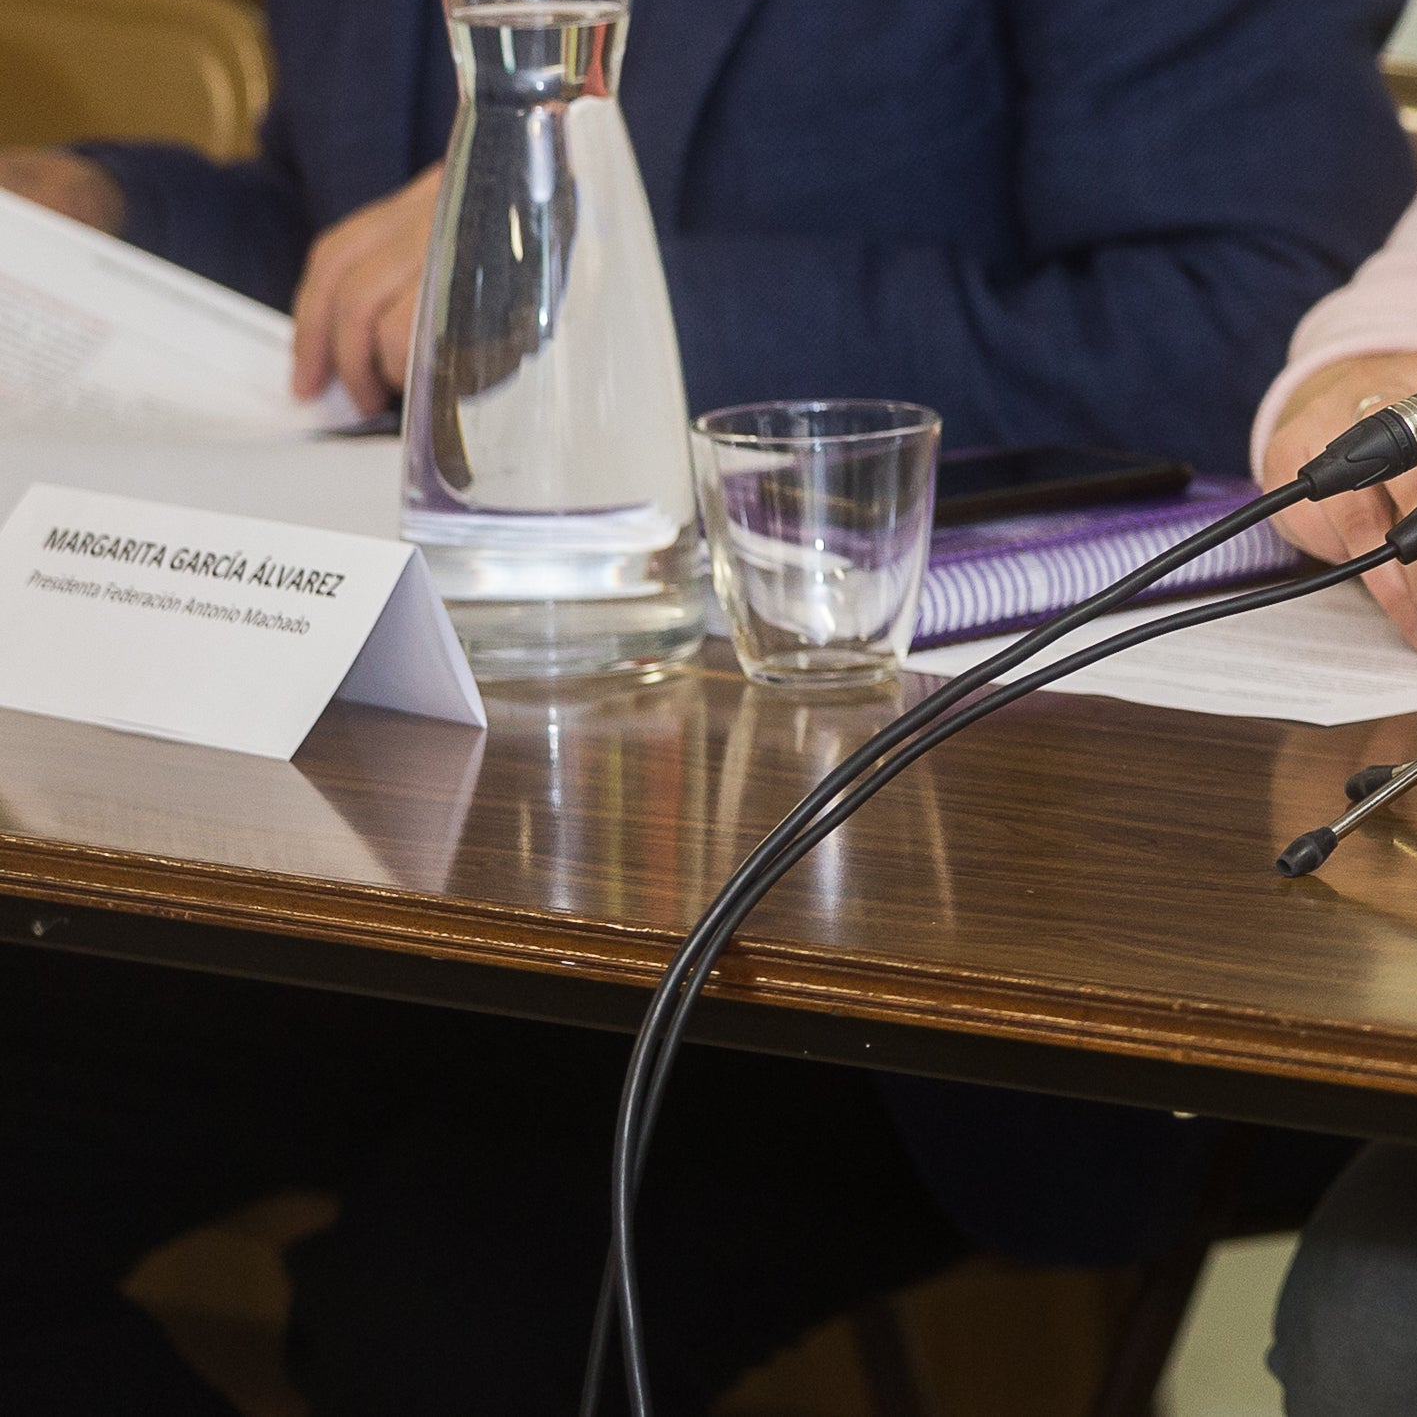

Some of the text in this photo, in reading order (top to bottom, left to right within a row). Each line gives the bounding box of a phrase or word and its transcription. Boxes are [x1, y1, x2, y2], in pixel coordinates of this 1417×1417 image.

[43, 527, 345, 598] MARGARITA GARCÍA ÁLVAREZ
[27, 569, 311, 635] Presidenta Federación Antonio Machado
